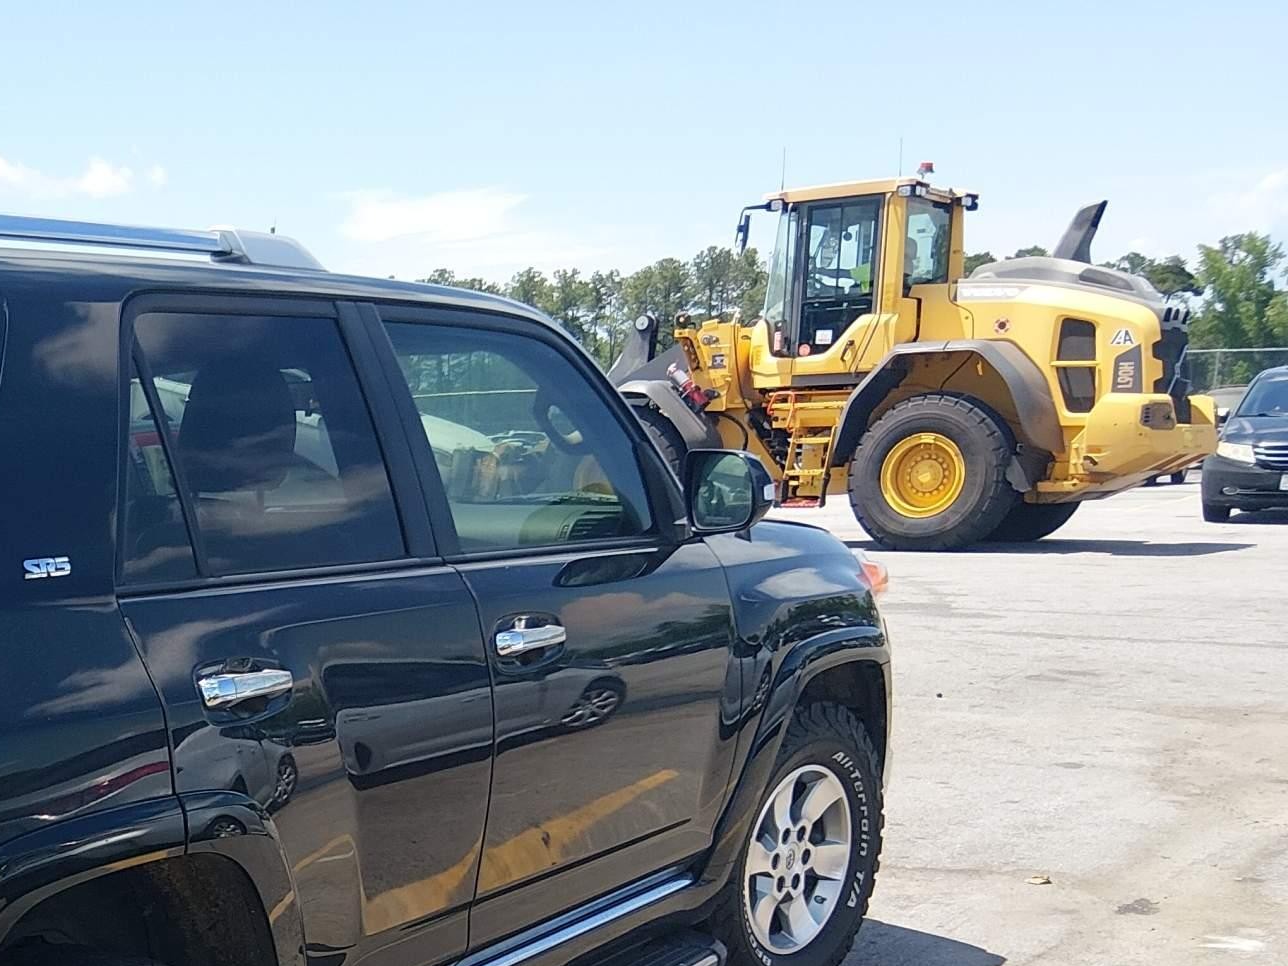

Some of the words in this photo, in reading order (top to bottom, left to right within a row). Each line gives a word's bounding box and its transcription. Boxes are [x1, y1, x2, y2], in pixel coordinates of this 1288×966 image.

[23, 556, 71, 579] SR5
[832, 751, 870, 857] All-Terrain
[847, 870, 865, 908] T/A
